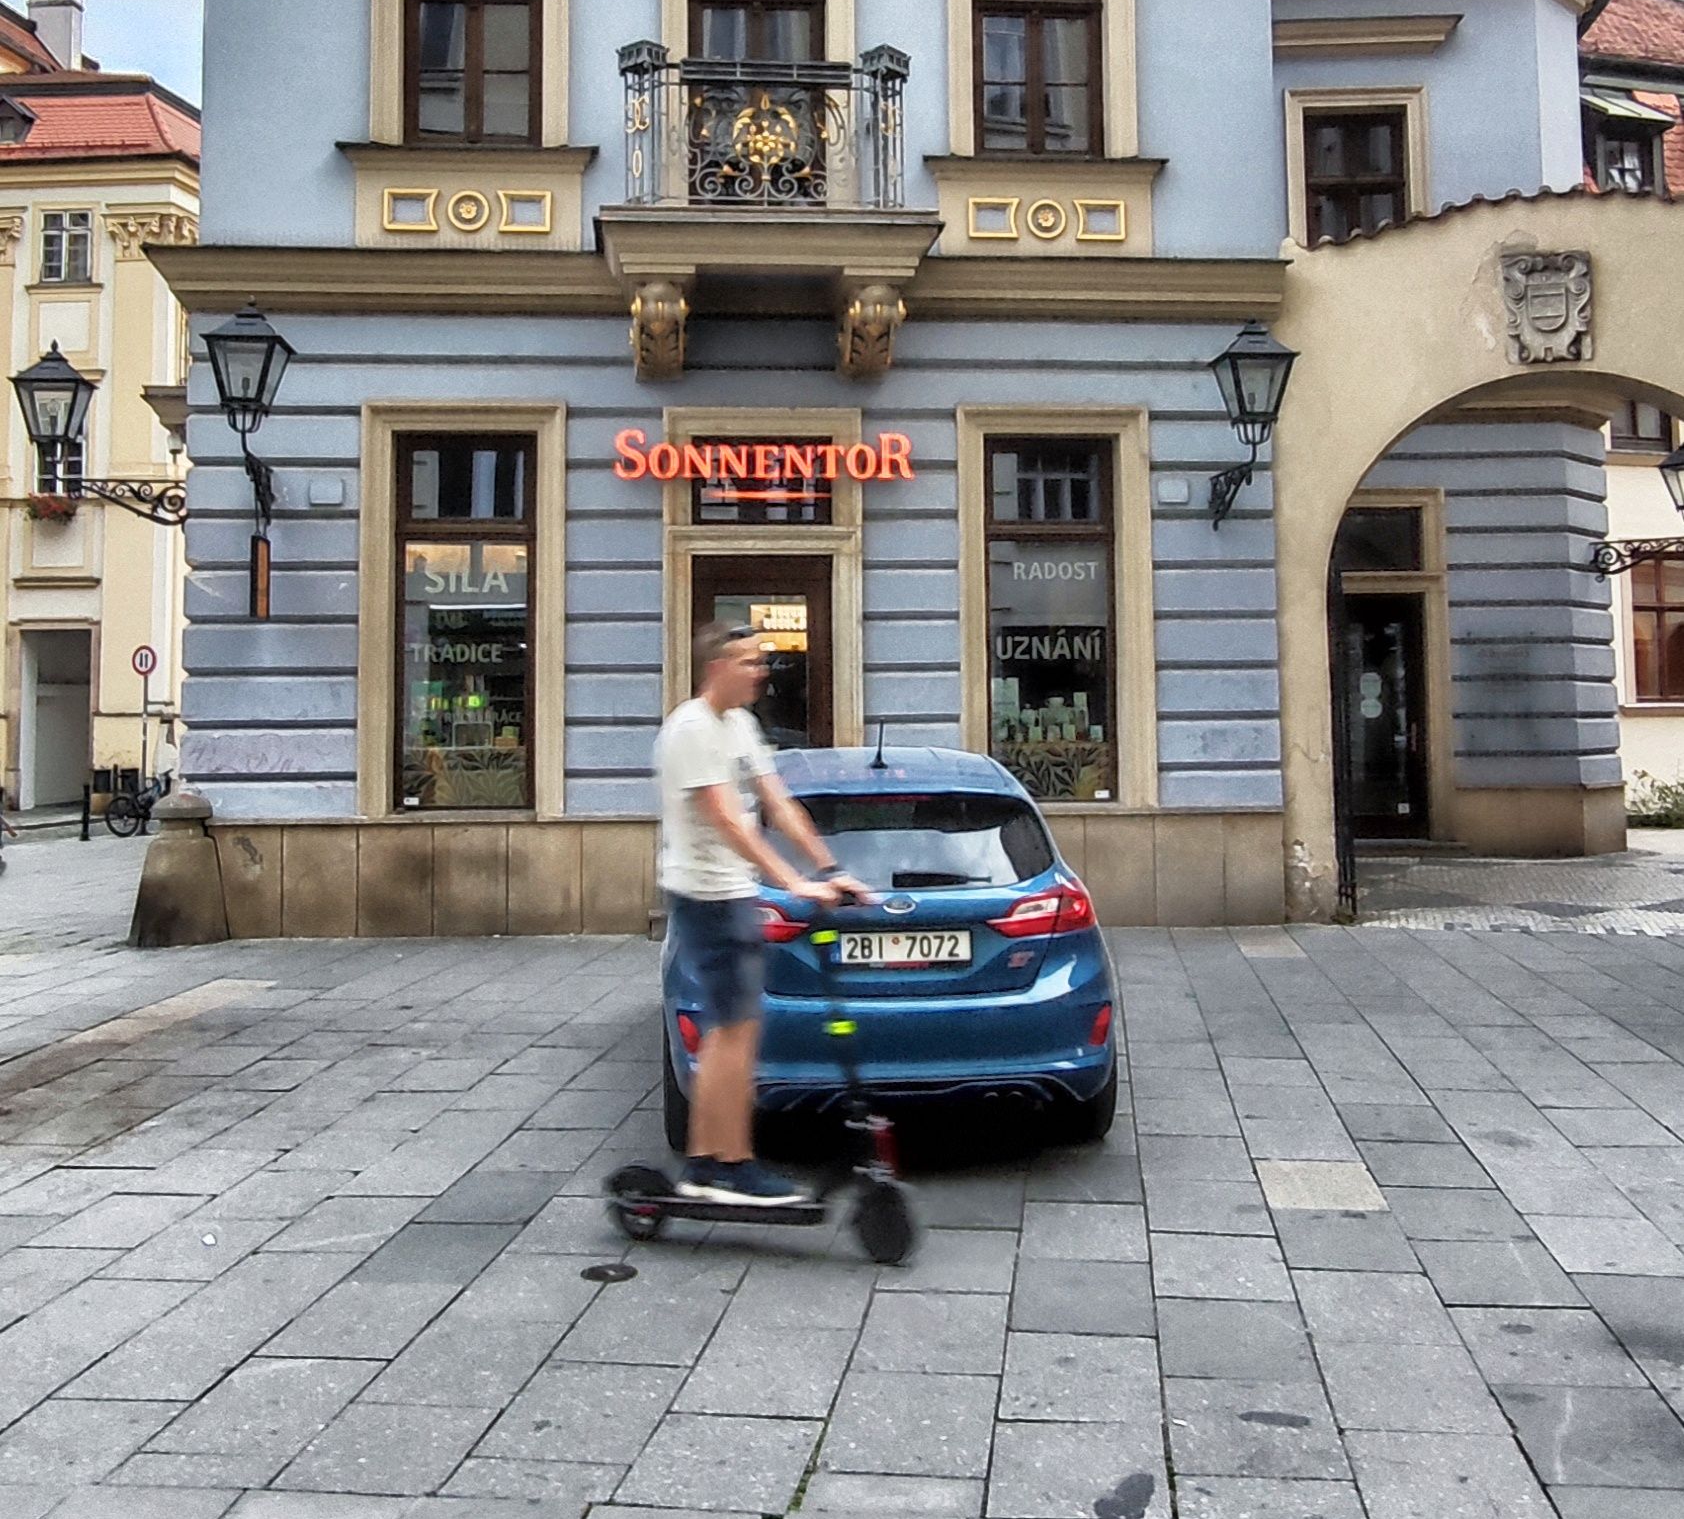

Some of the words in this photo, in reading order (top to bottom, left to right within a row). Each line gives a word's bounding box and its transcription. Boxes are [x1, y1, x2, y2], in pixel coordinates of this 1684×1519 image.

[613, 428, 916, 481] SONNENTOR
[1013, 561, 1099, 580] RADOST
[410, 643, 504, 663] TRADICE
[996, 628, 1101, 660] UZNÁNÍ
[846, 937, 883, 960] 2BI
[905, 934, 960, 958] 7072
